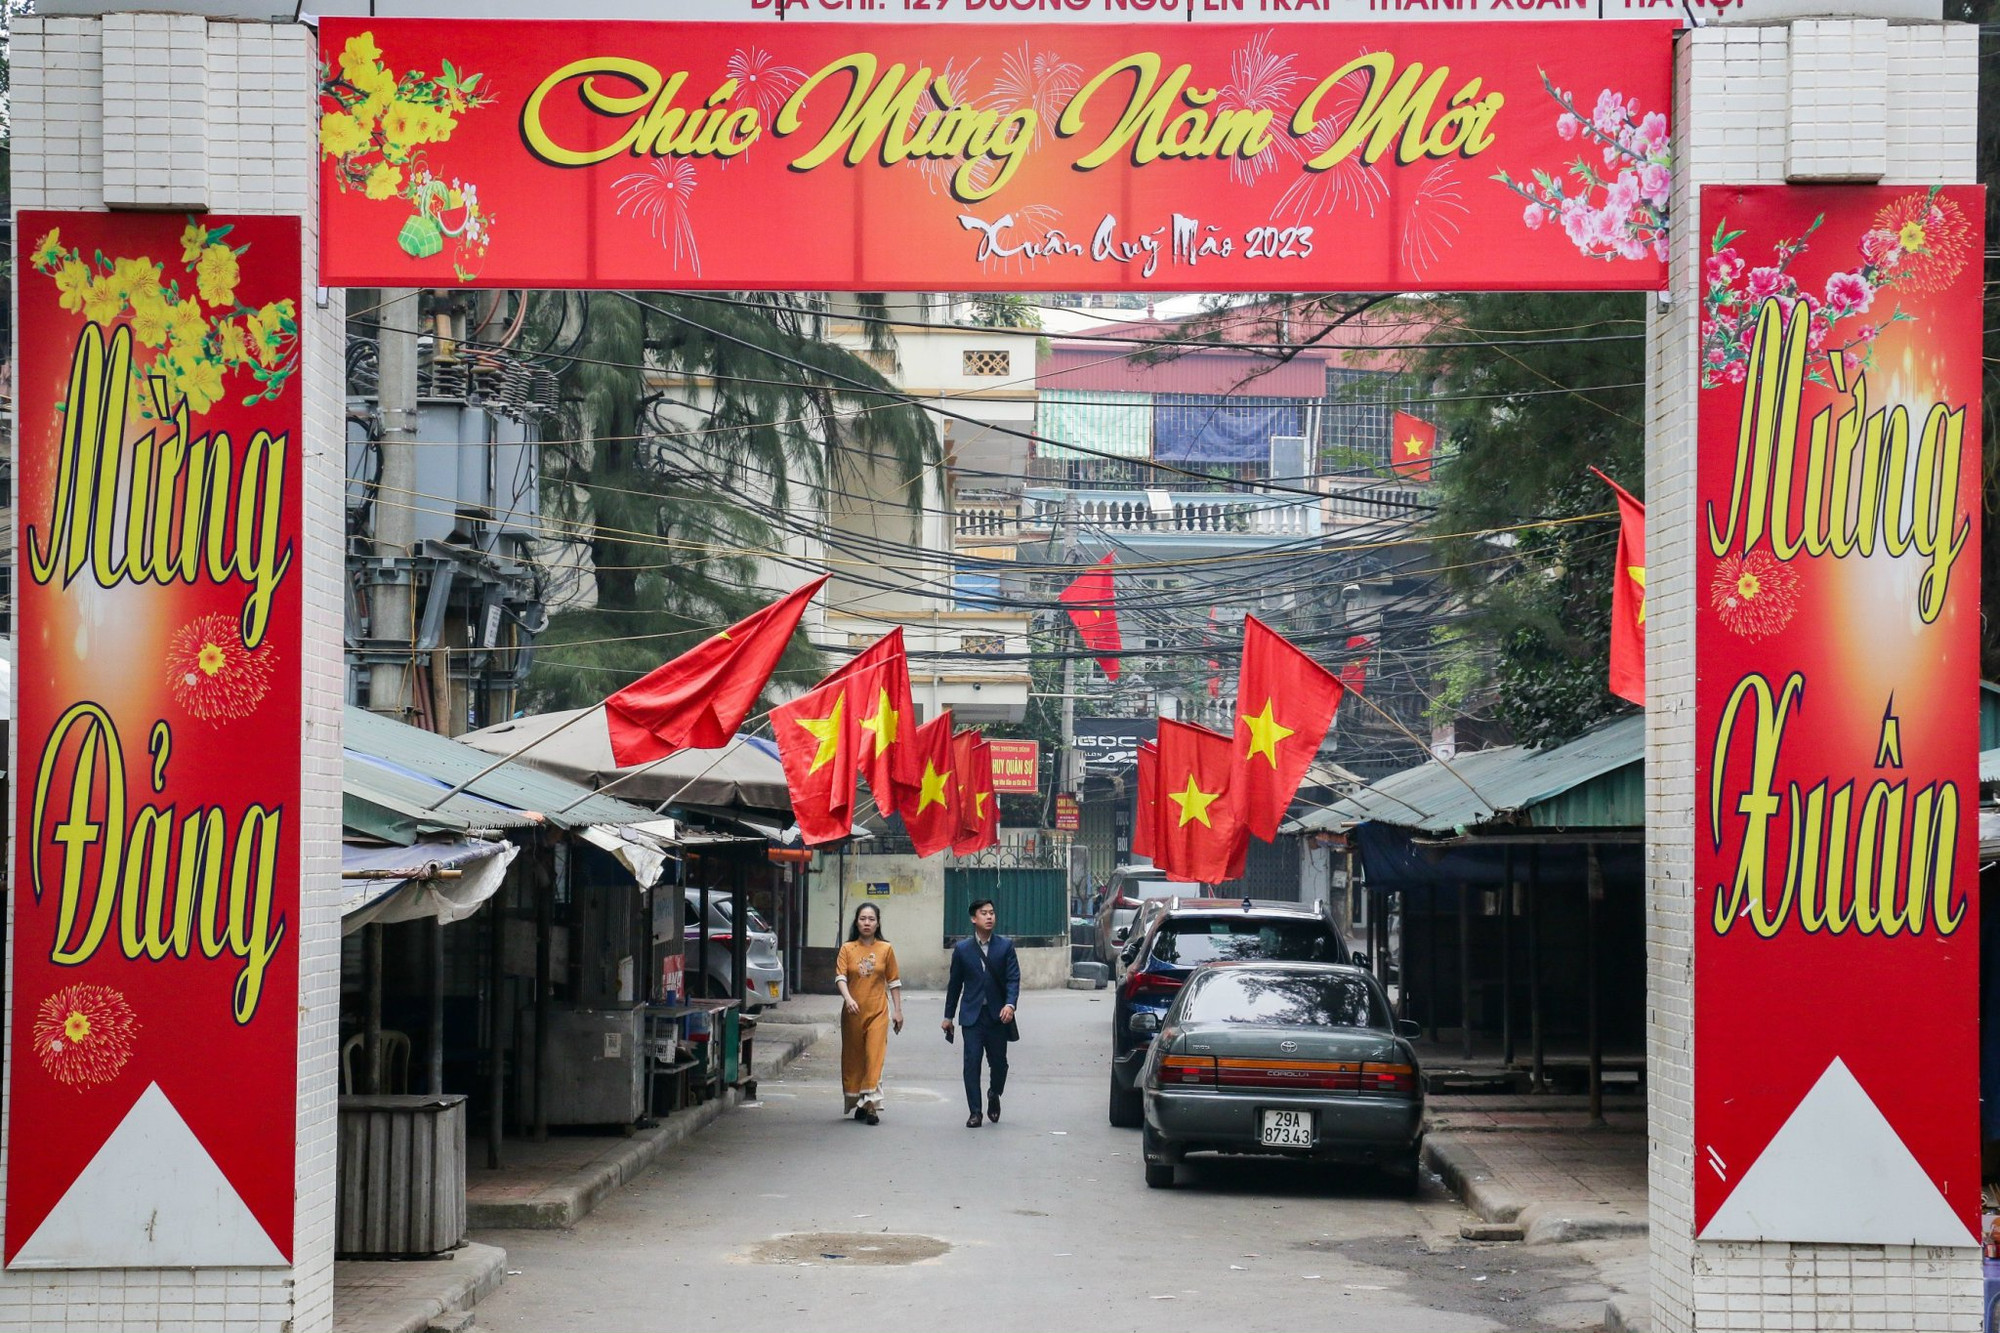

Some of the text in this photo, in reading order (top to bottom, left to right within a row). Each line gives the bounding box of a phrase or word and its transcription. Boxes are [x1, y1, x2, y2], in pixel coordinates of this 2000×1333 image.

[520, 51, 1505, 201] Chúc Mừng Năm Mới
[958, 213, 1314, 278] Xuân Quý Mão 2023
[27, 320, 293, 649] Mừng
[1707, 296, 1970, 624] Mừng
[992, 758, 1005, 774] HUY
[1072, 735, 1137, 750] GỌC
[1710, 671, 1968, 940] Xuân
[30, 700, 286, 1026] Đảng
[1265, 1128, 1310, 1144] 873.43
[1275, 1112, 1300, 1127] 29A
